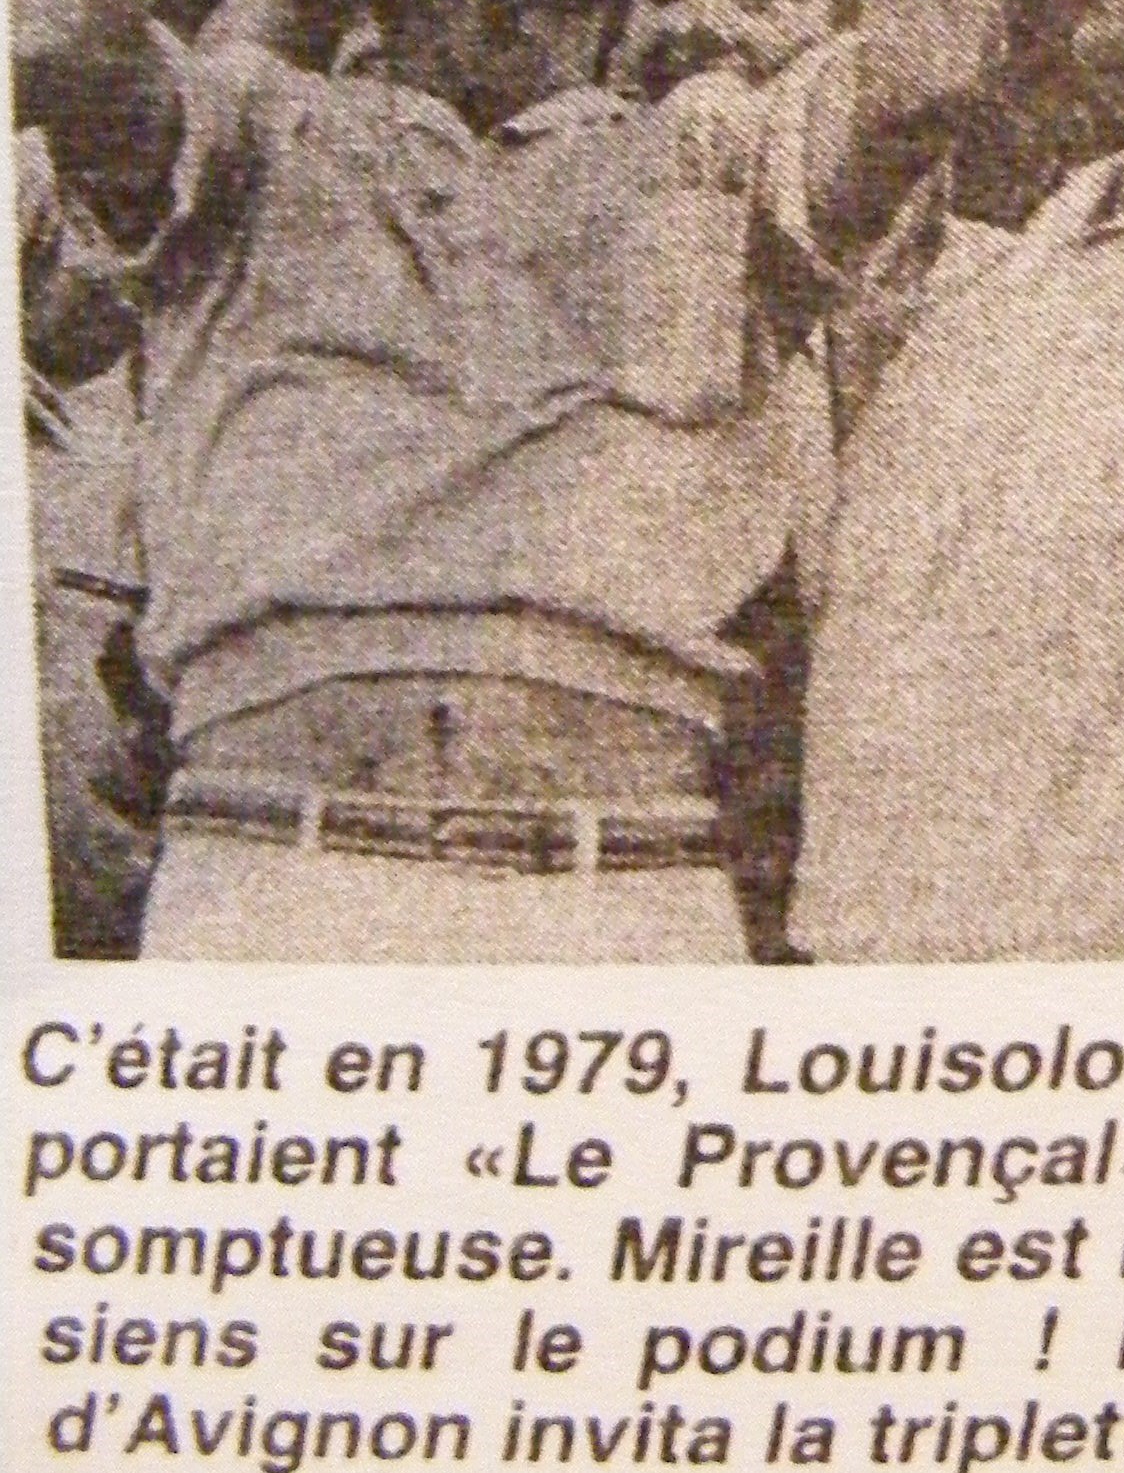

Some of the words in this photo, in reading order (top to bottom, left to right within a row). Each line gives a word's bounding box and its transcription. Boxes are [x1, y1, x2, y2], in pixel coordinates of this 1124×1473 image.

[20, 1021, 290, 1094] C'était
[325, 1040, 427, 1095] en
[478, 1028, 690, 1109] 1979,
[22, 1120, 404, 1199] portaient
[465, 1121, 614, 1191] «Le
[32, 1215, 573, 1296] somptueuse.
[609, 1215, 924, 1285] Mireille
[955, 1217, 1091, 1284] est
[40, 1301, 259, 1369] siens
[315, 1320, 456, 1375] sur
[512, 1308, 585, 1376] le
[636, 1309, 967, 1393] podium
[1034, 1306, 1061, 1373] !
[46, 1391, 472, 1473] d'Avignon
[501, 1399, 734, 1467] invita
[764, 1401, 837, 1467] la
